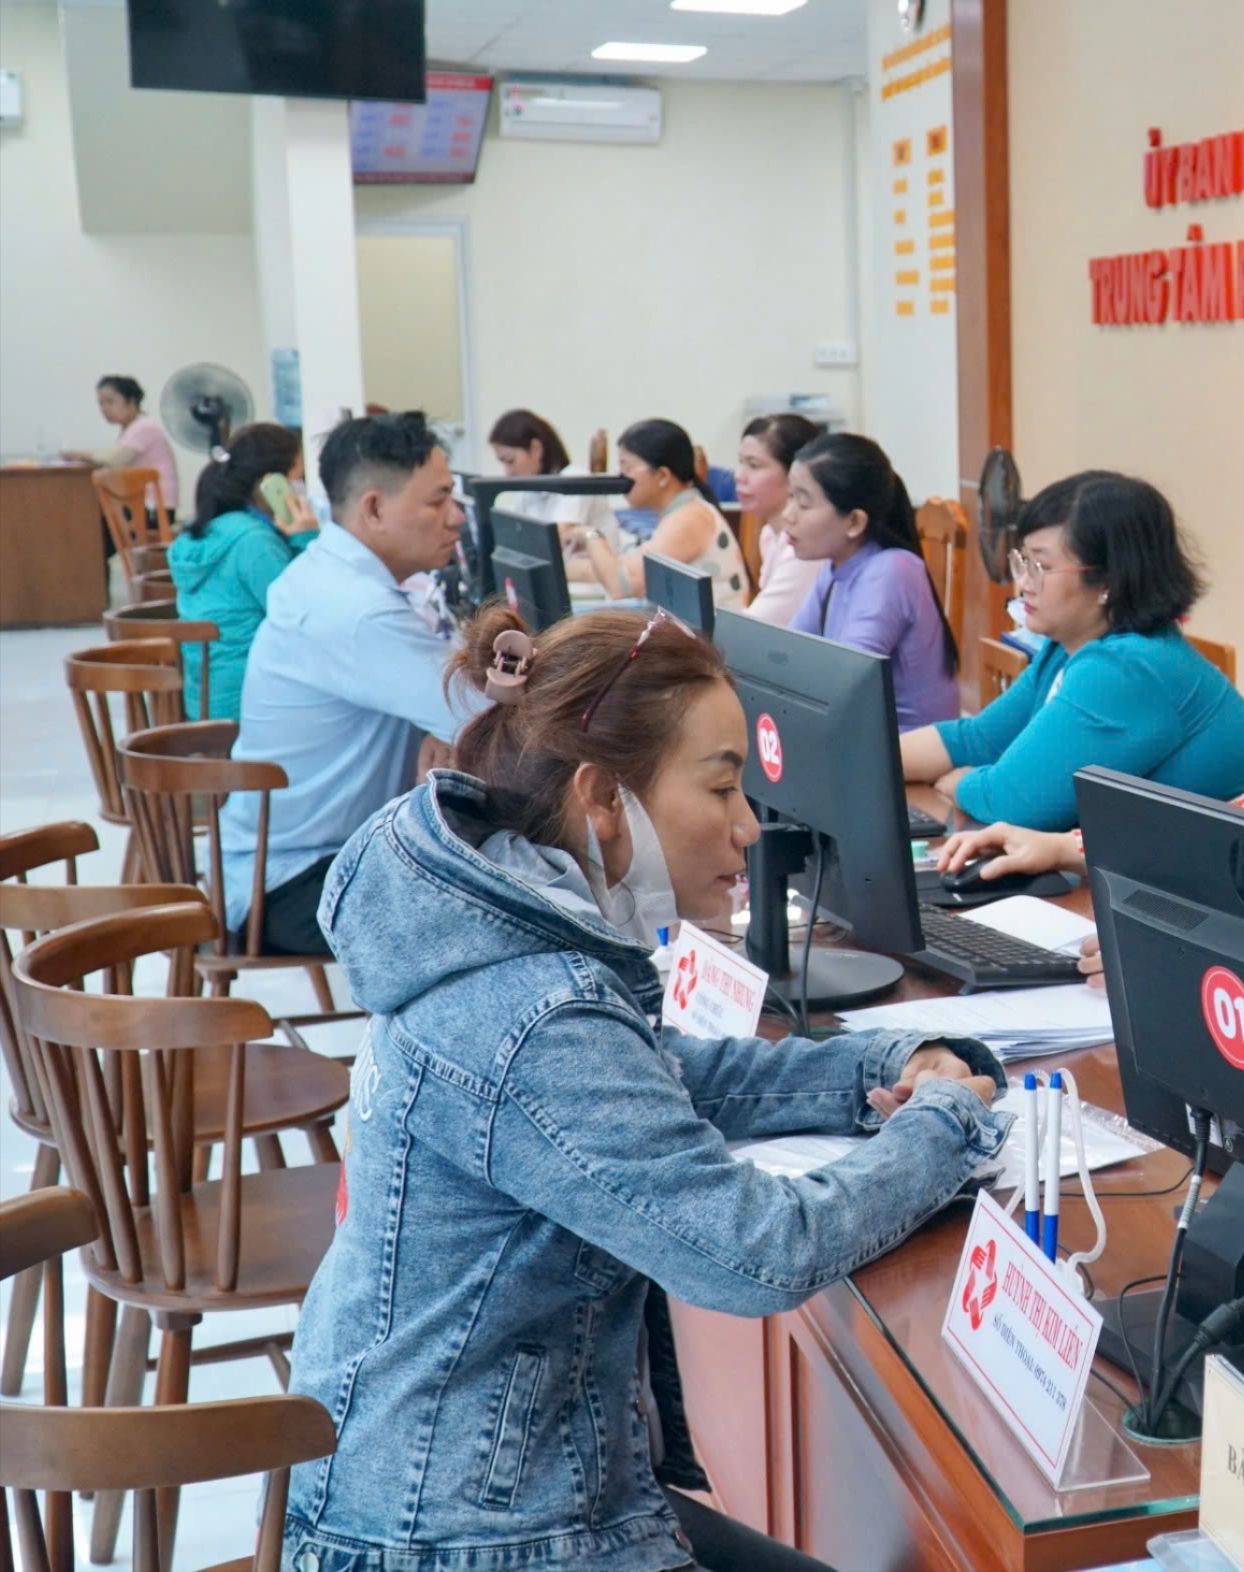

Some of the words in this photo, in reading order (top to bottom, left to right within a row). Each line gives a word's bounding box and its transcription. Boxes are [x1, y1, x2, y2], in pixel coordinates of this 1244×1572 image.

[1145, 127, 1178, 208] ỦY
[1179, 132, 1242, 204] BAN
[1089, 250, 1169, 325] TRUNG
[1169, 223, 1234, 322] TÂM
[759, 728, 780, 766] 02
[1029, 1290, 1047, 1338] THỊ
[1042, 1306, 1063, 1349] KIM
